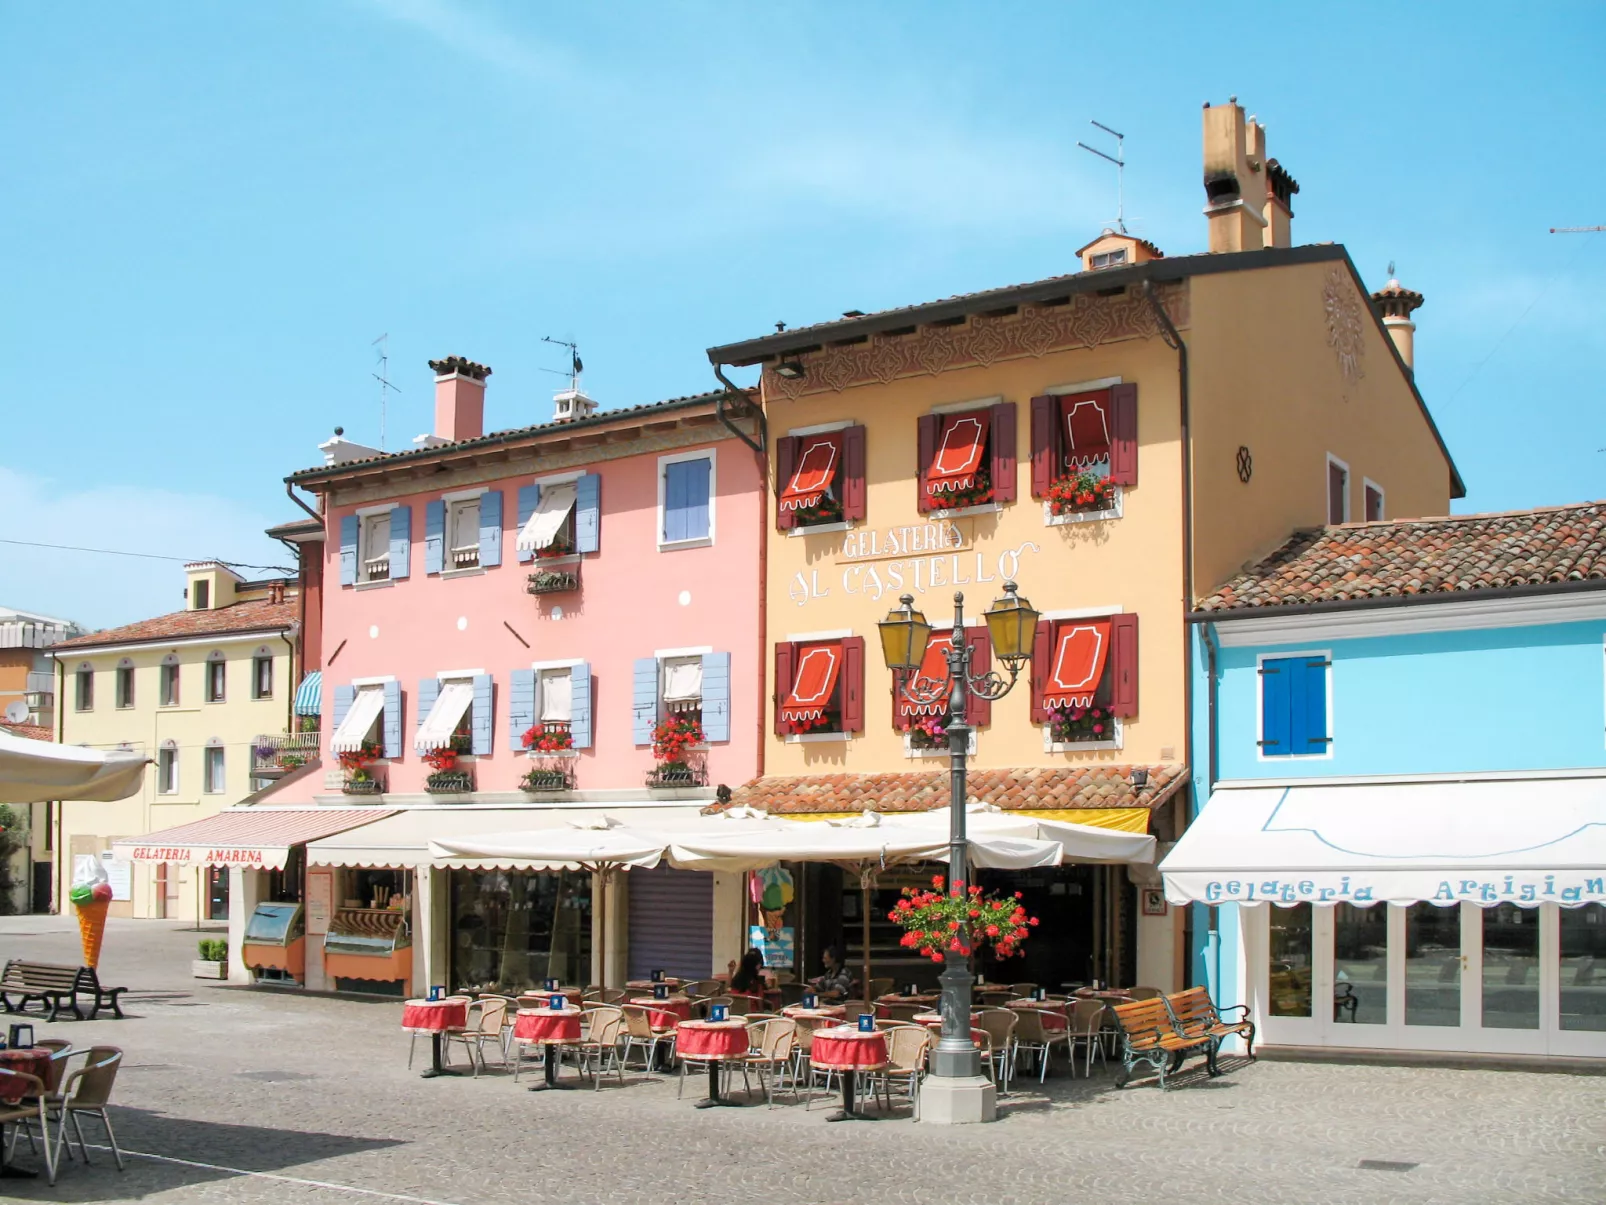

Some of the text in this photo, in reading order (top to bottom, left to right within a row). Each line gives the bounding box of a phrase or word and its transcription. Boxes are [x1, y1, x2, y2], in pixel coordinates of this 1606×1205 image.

[843, 521, 963, 558] GELATERIA
[789, 542, 1040, 606] AL CASTELLO
[133, 848, 262, 862] GELATERIA AMARENA
[1205, 876, 1373, 900] Gelateria
